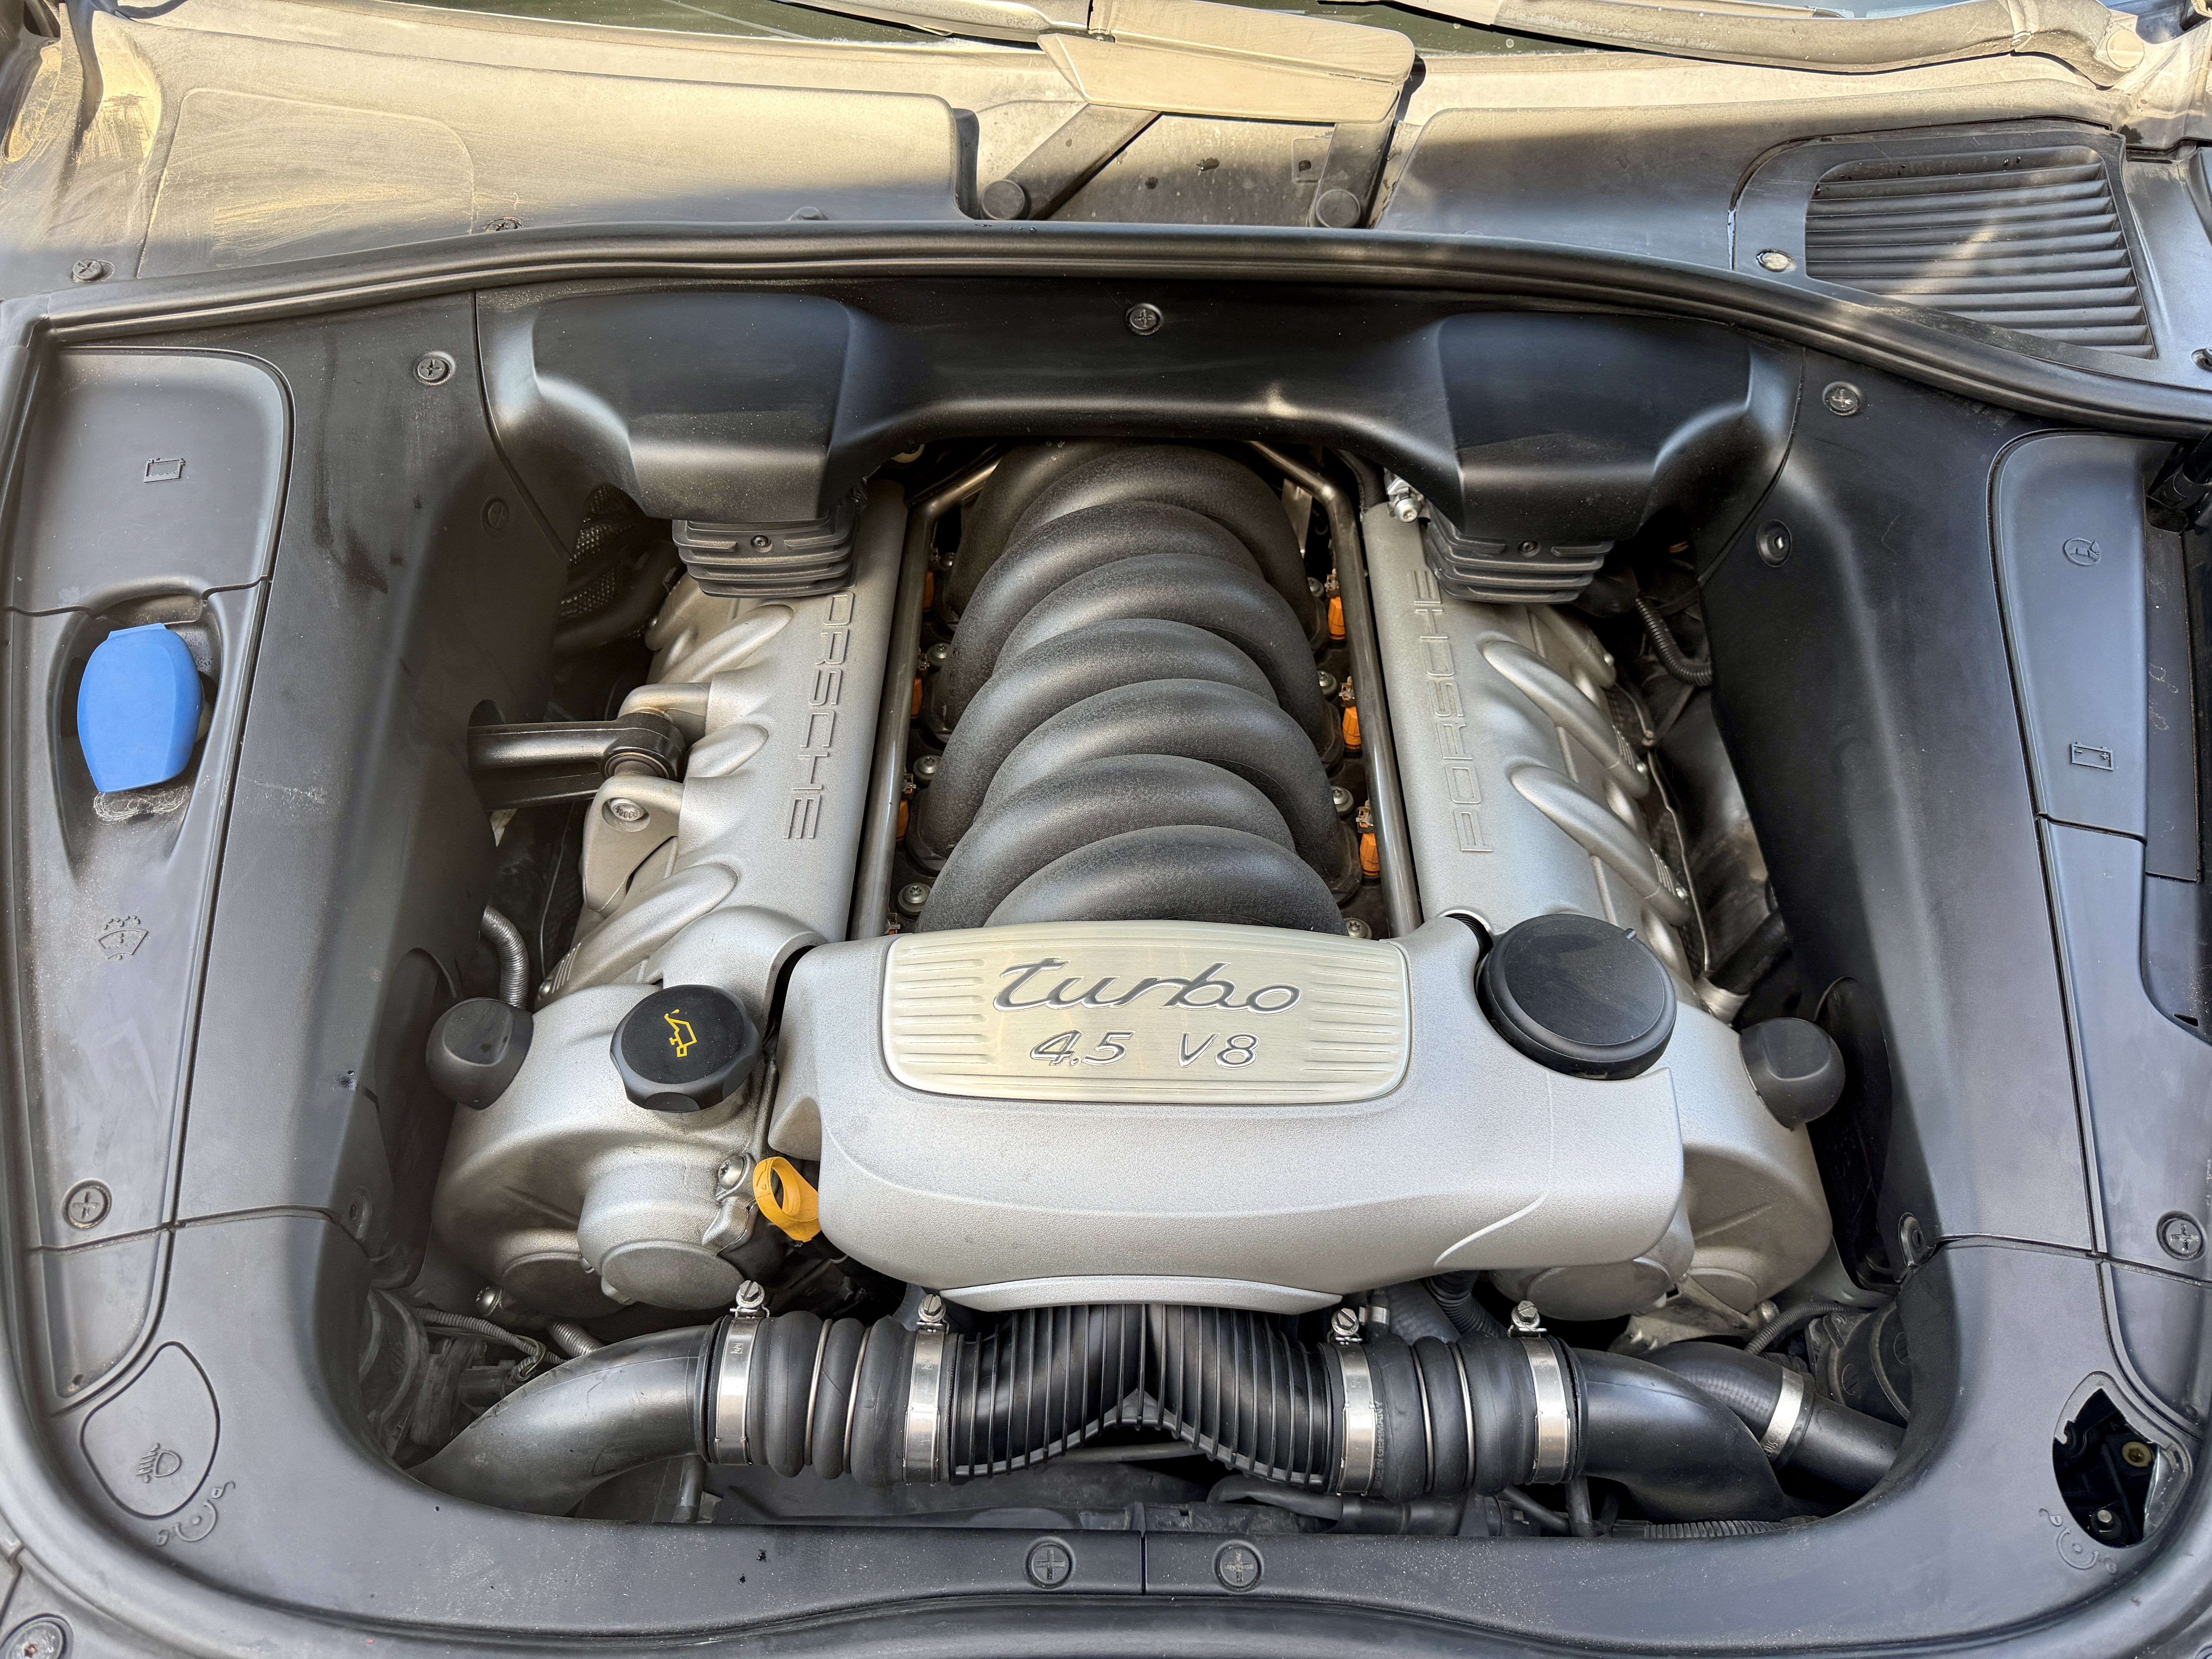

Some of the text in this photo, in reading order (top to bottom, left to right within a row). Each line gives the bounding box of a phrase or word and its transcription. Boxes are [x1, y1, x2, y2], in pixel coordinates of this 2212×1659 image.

[782, 591, 855, 839] ORSCHE
[1410, 569, 1493, 853] PORSCHE
[993, 956, 1303, 1016] turbo
[1030, 1029, 1261, 1069] 4.5 V8
